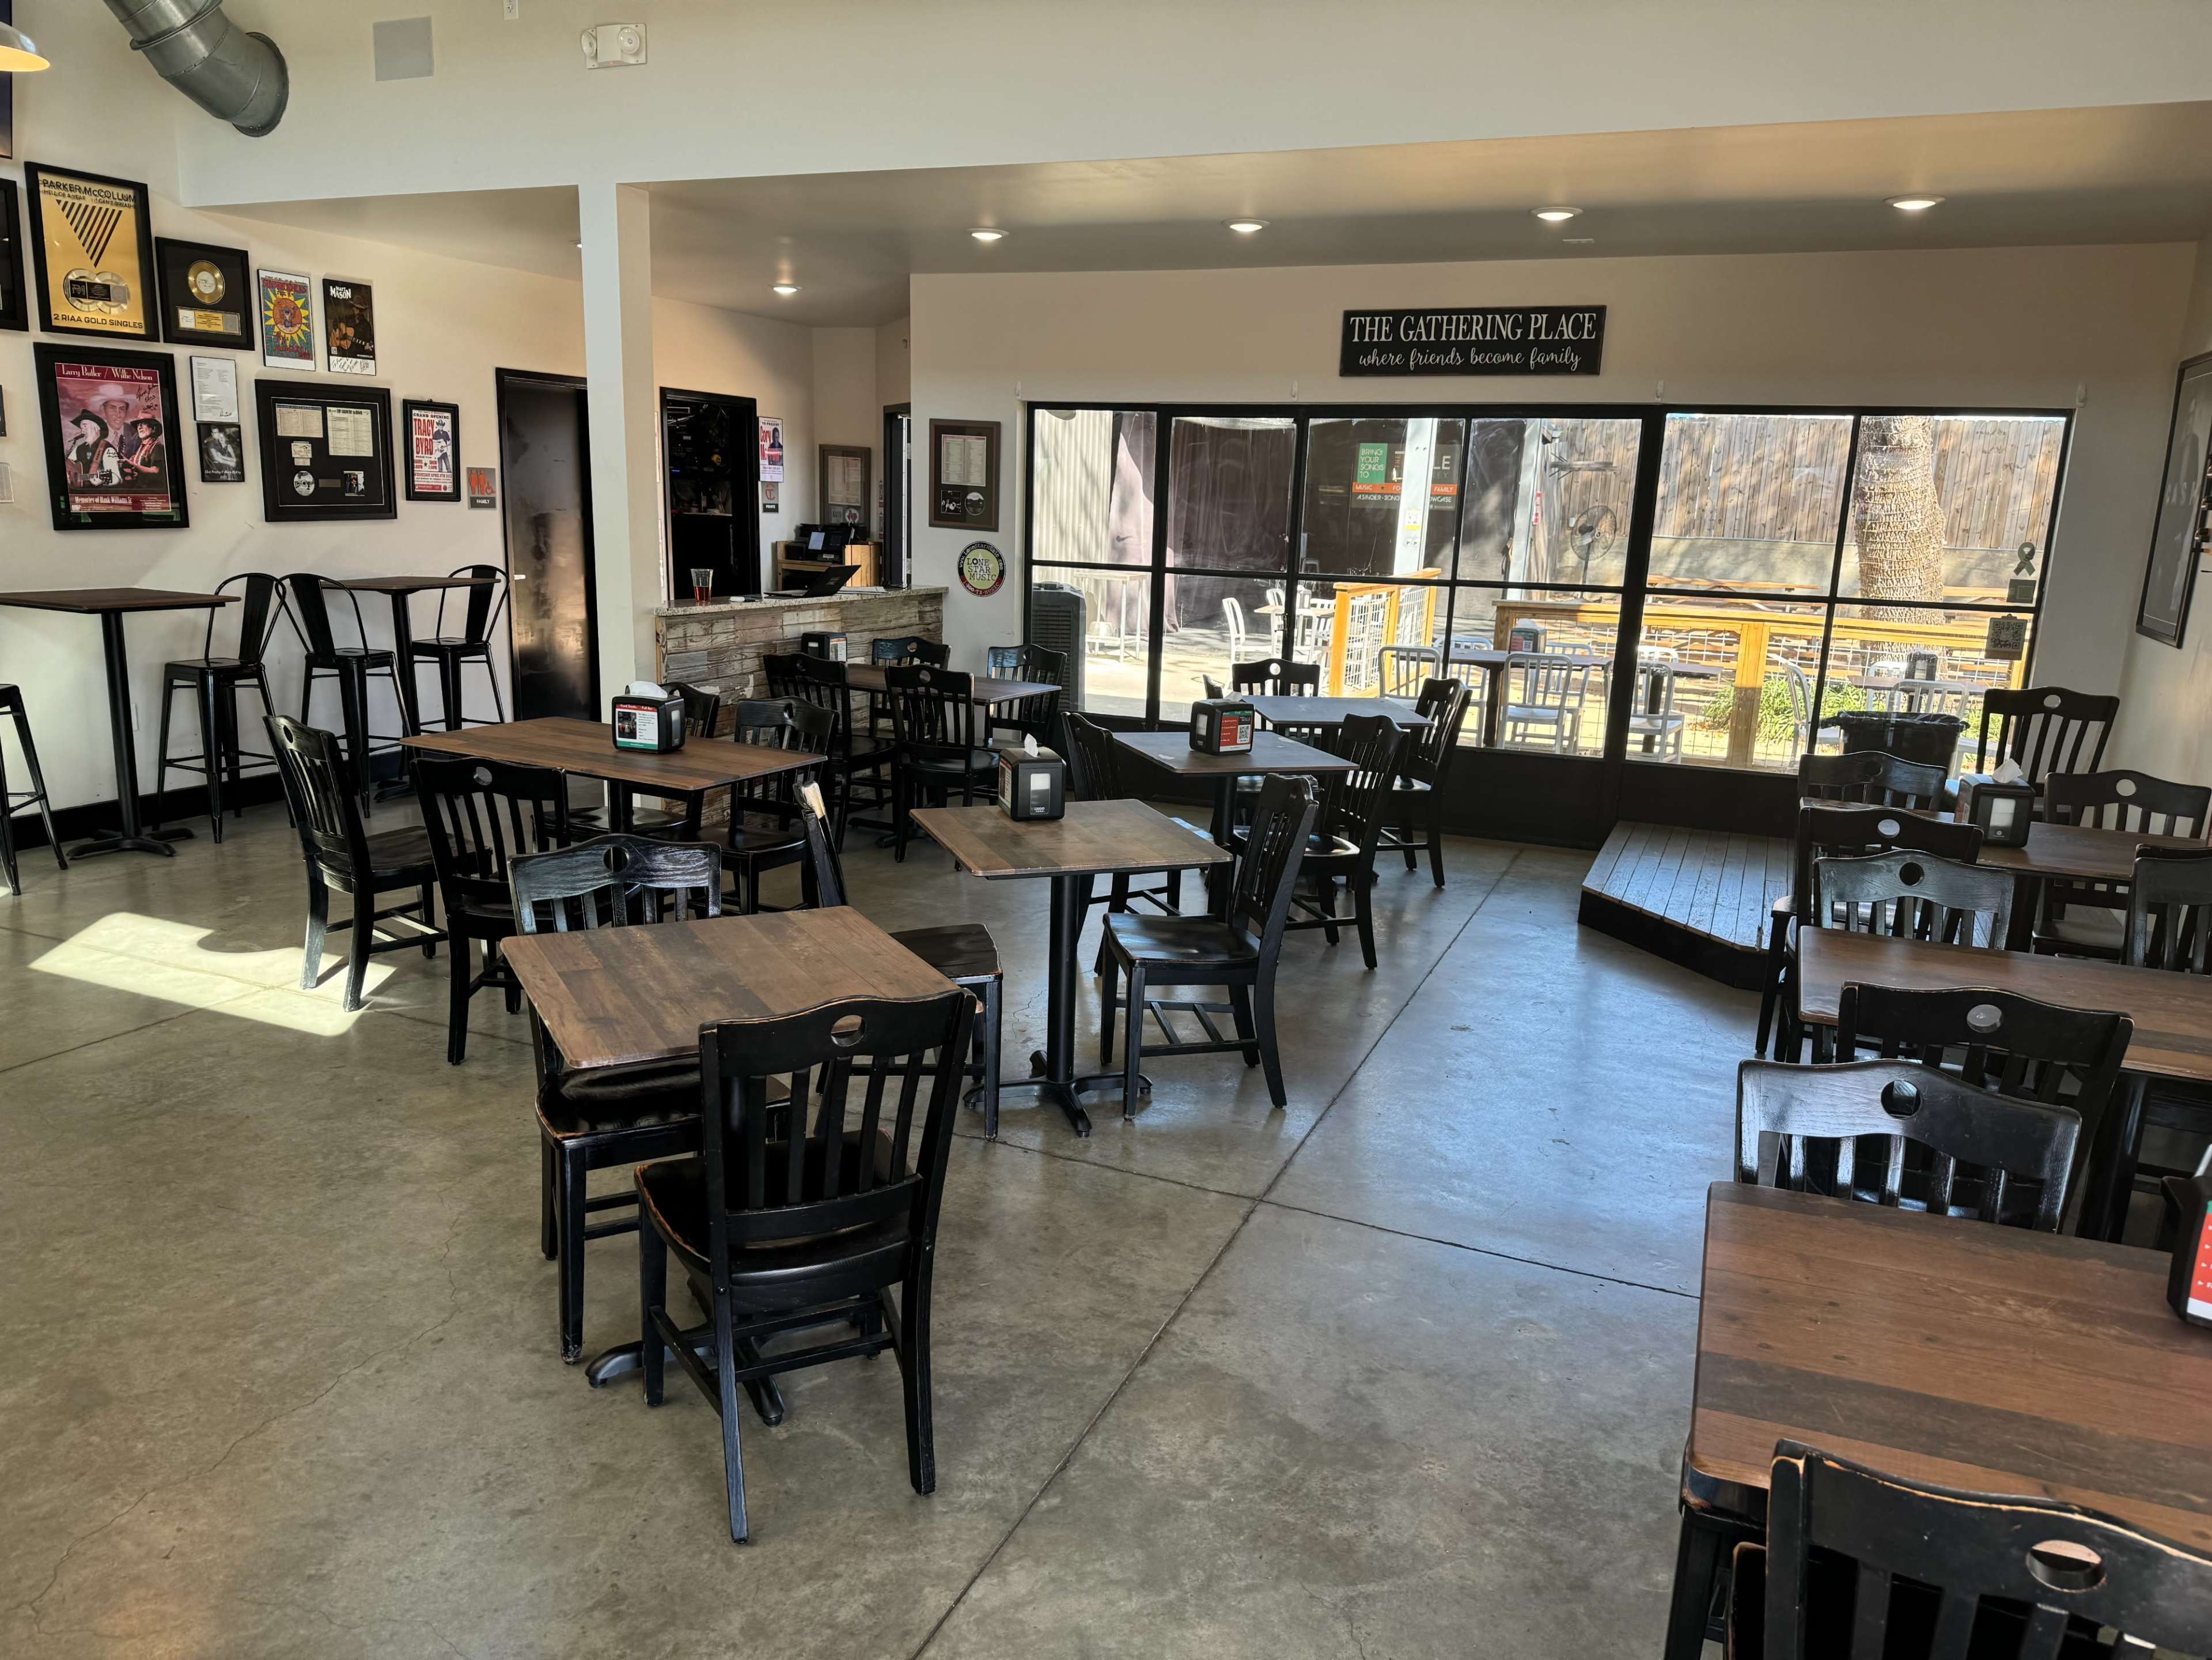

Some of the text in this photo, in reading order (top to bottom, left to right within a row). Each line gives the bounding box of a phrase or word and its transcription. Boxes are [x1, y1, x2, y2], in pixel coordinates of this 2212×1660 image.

[43, 179, 81, 192] PARKER
[329, 286, 351, 299] MASON
[62, 314, 82, 323] RIAA
[84, 317, 107, 325] GOLD
[109, 319, 143, 329] SINGLES
[1350, 313, 1596, 342] THE GATHERING PLACE
[1359, 346, 1582, 372] where friends become family
[62, 364, 80, 377] Larry
[81, 365, 101, 377] Butler
[111, 367, 132, 379] Willie
[132, 369, 153, 380] Nelson
[414, 418, 434, 436] TRACY
[760, 426, 771, 444] Cory
[415, 437, 434, 455] BYRD
[95, 496, 100, 504] of
[967, 558, 990, 566] LONE
[968, 565, 991, 574] STAR
[969, 573, 997, 581] MUSIC
